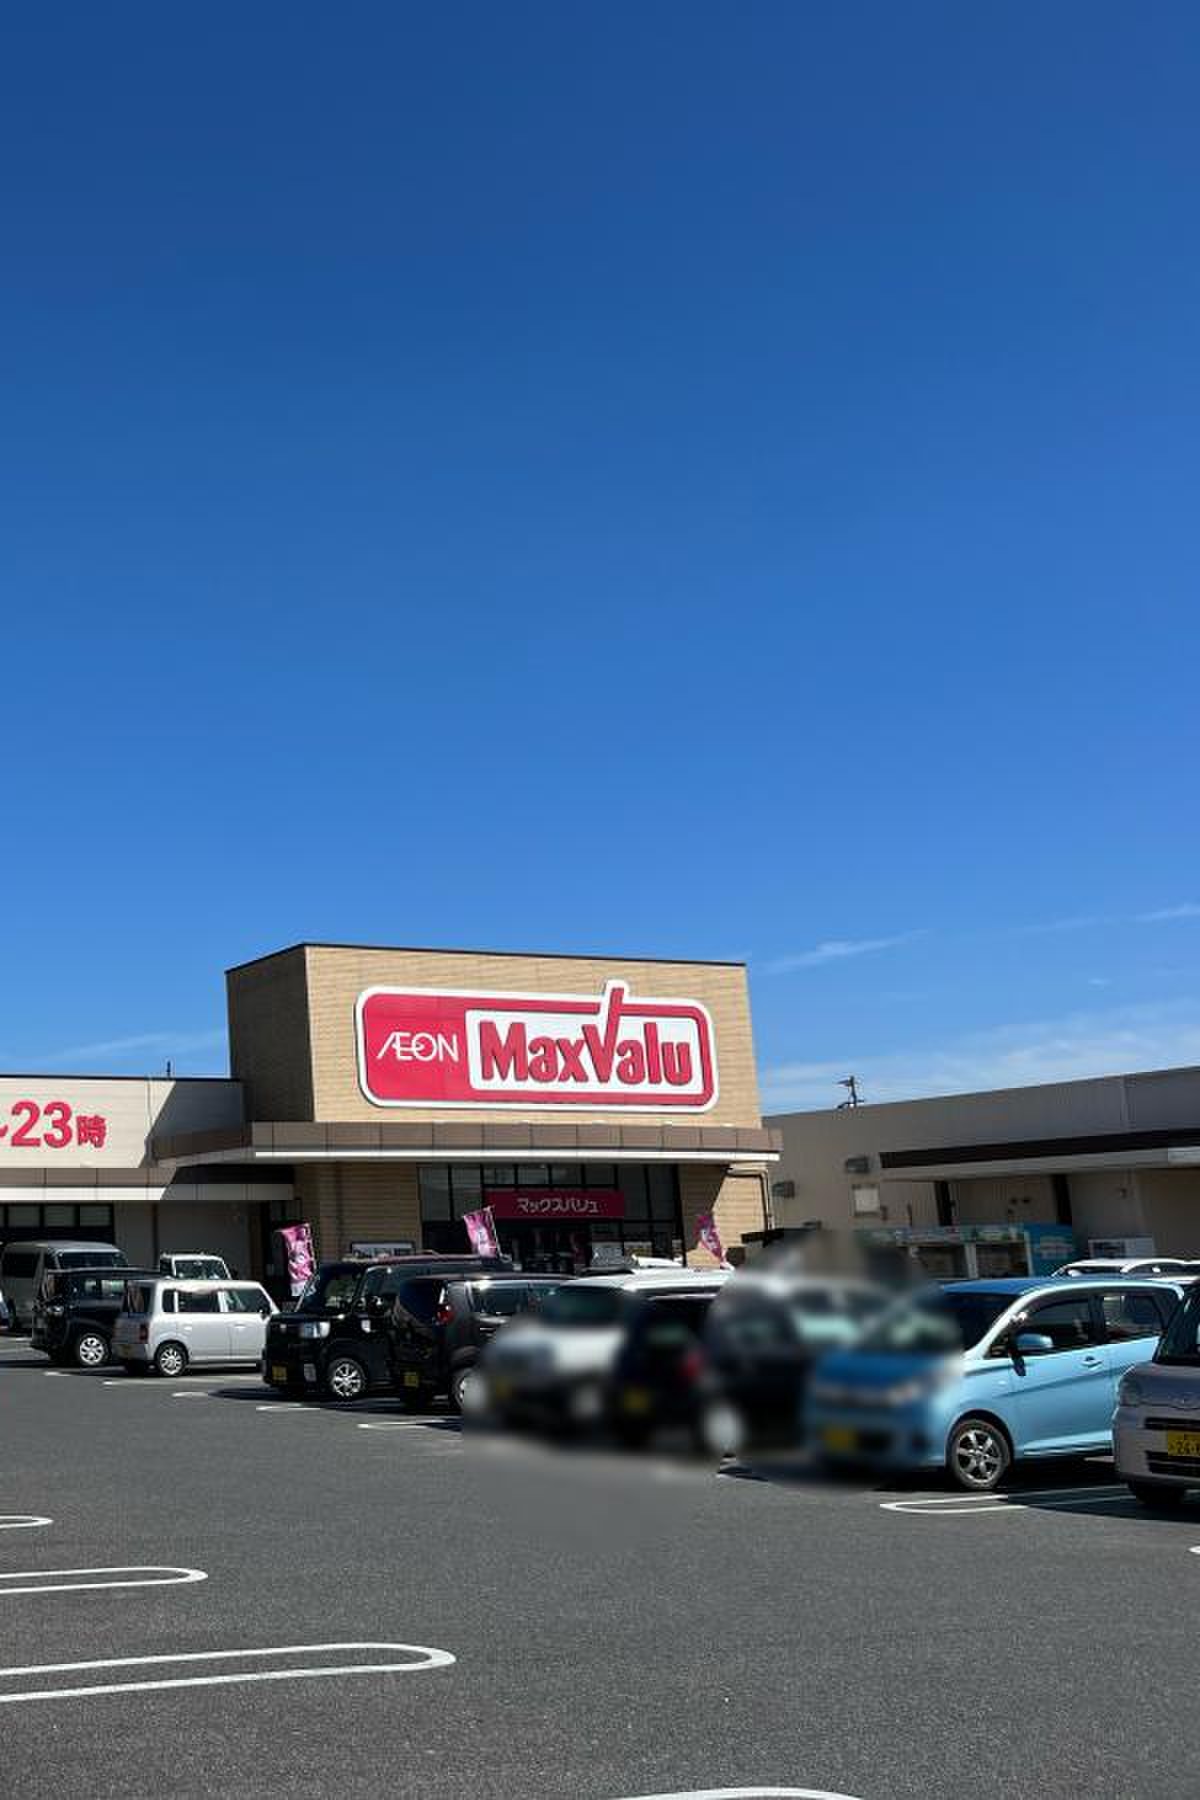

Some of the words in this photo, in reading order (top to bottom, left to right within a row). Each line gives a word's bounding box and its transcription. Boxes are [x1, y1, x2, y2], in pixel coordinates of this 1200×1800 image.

[478, 987, 694, 1086] MaxValu
[516, 1197, 599, 1214] マックスバリュ
